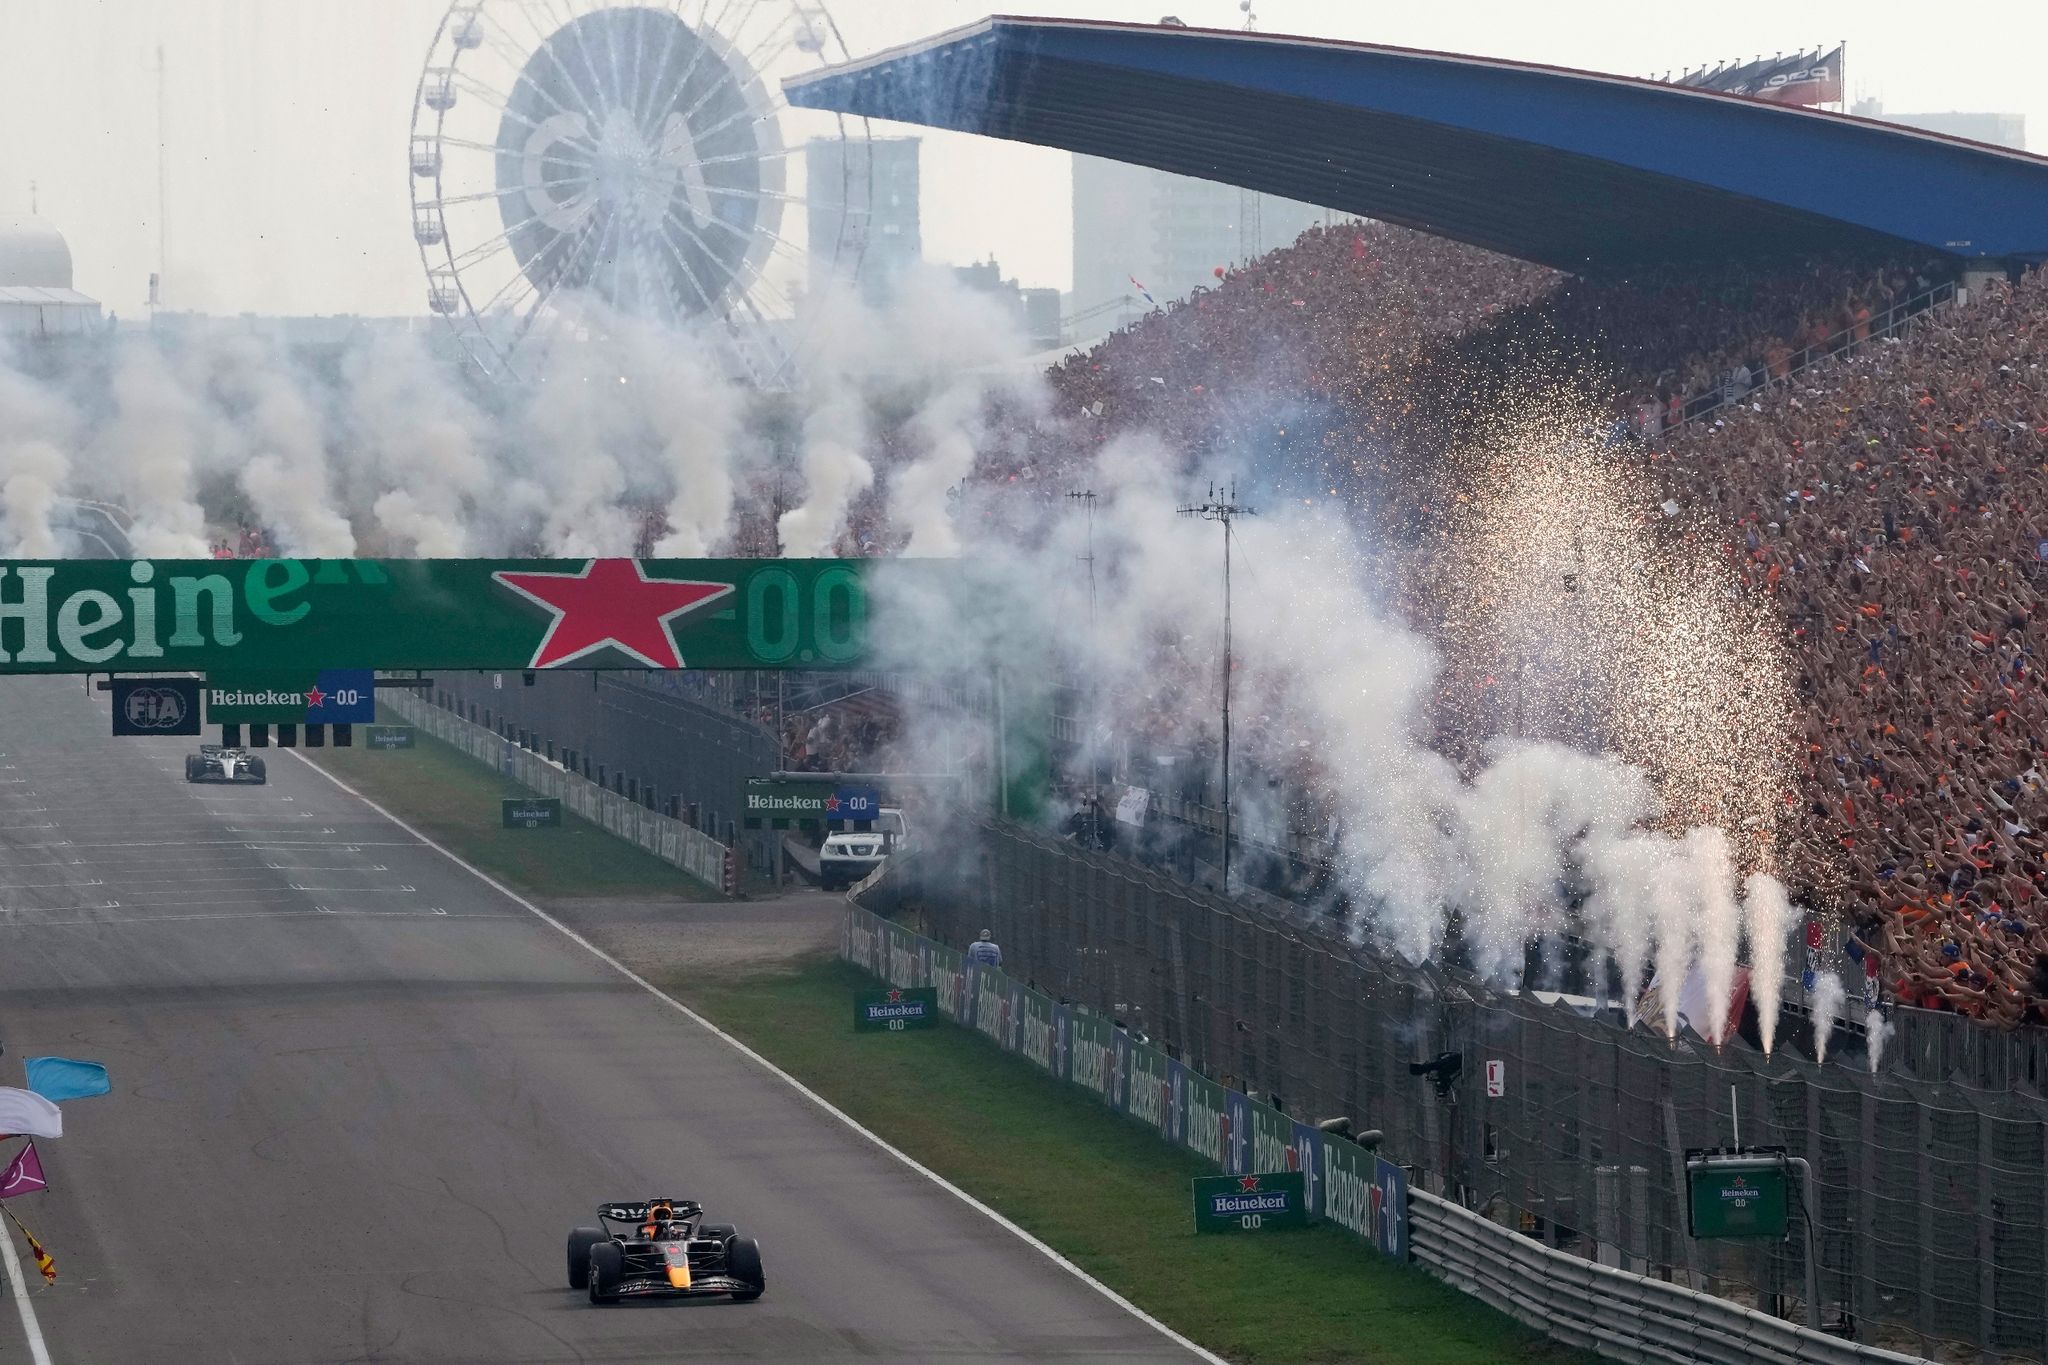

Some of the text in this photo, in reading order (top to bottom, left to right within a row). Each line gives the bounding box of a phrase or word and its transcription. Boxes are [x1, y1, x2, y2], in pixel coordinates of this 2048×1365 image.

[211, 689, 358, 706] Heineken 0.0
[748, 794, 822, 809] Heineken
[512, 810, 550, 819] Heineken
[869, 1005, 923, 1018] Heineken
[889, 1019, 904, 1031] 0.0
[1324, 1143, 1370, 1239] Heineken
[1721, 1189, 1759, 1197] Heineken
[1215, 1195, 1286, 1212] Heineken
[1241, 1214, 1262, 1230] 0.0
